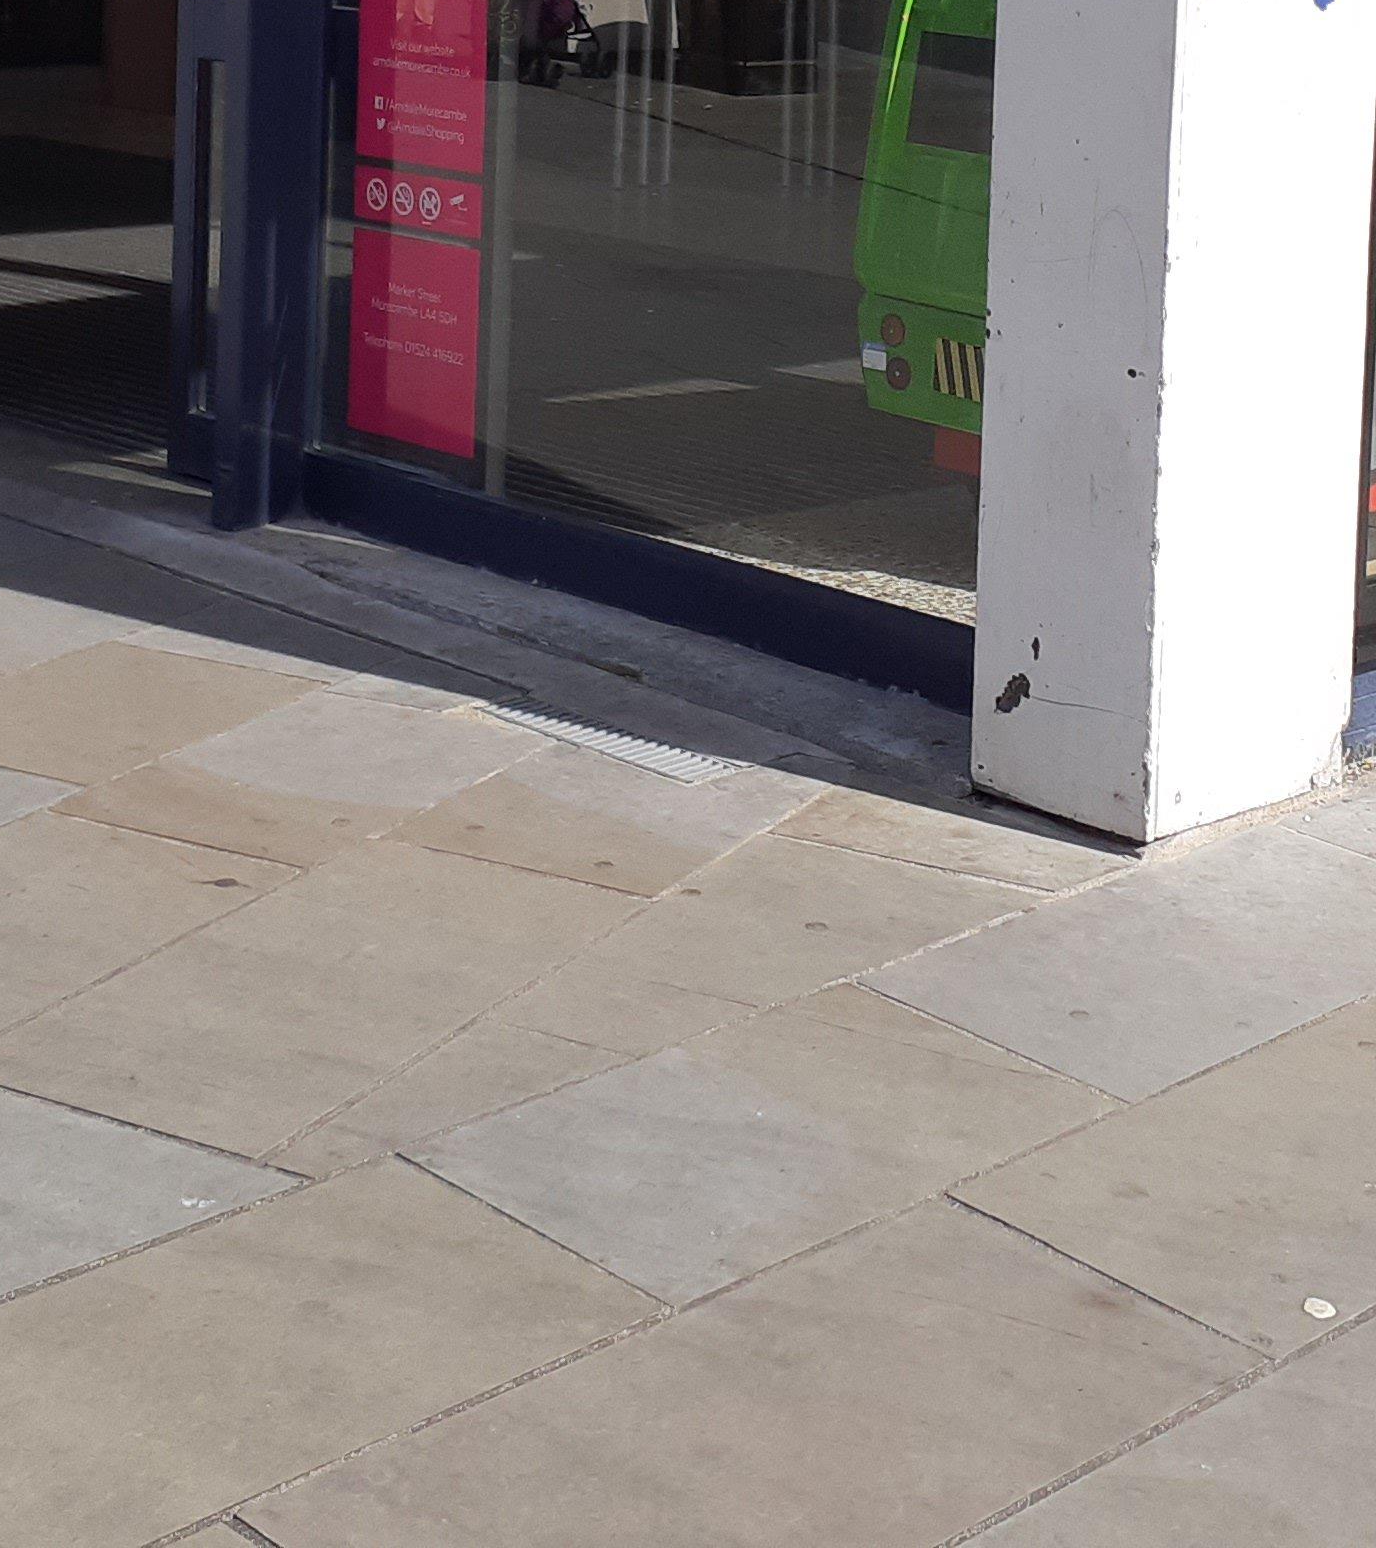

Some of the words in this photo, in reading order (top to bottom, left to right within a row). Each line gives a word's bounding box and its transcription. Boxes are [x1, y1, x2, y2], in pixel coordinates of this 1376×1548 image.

[389, 36, 408, 52] Visit
[407, 43, 423, 54] our
[388, 281, 416, 297] Market
[404, 340, 431, 358] 01524
